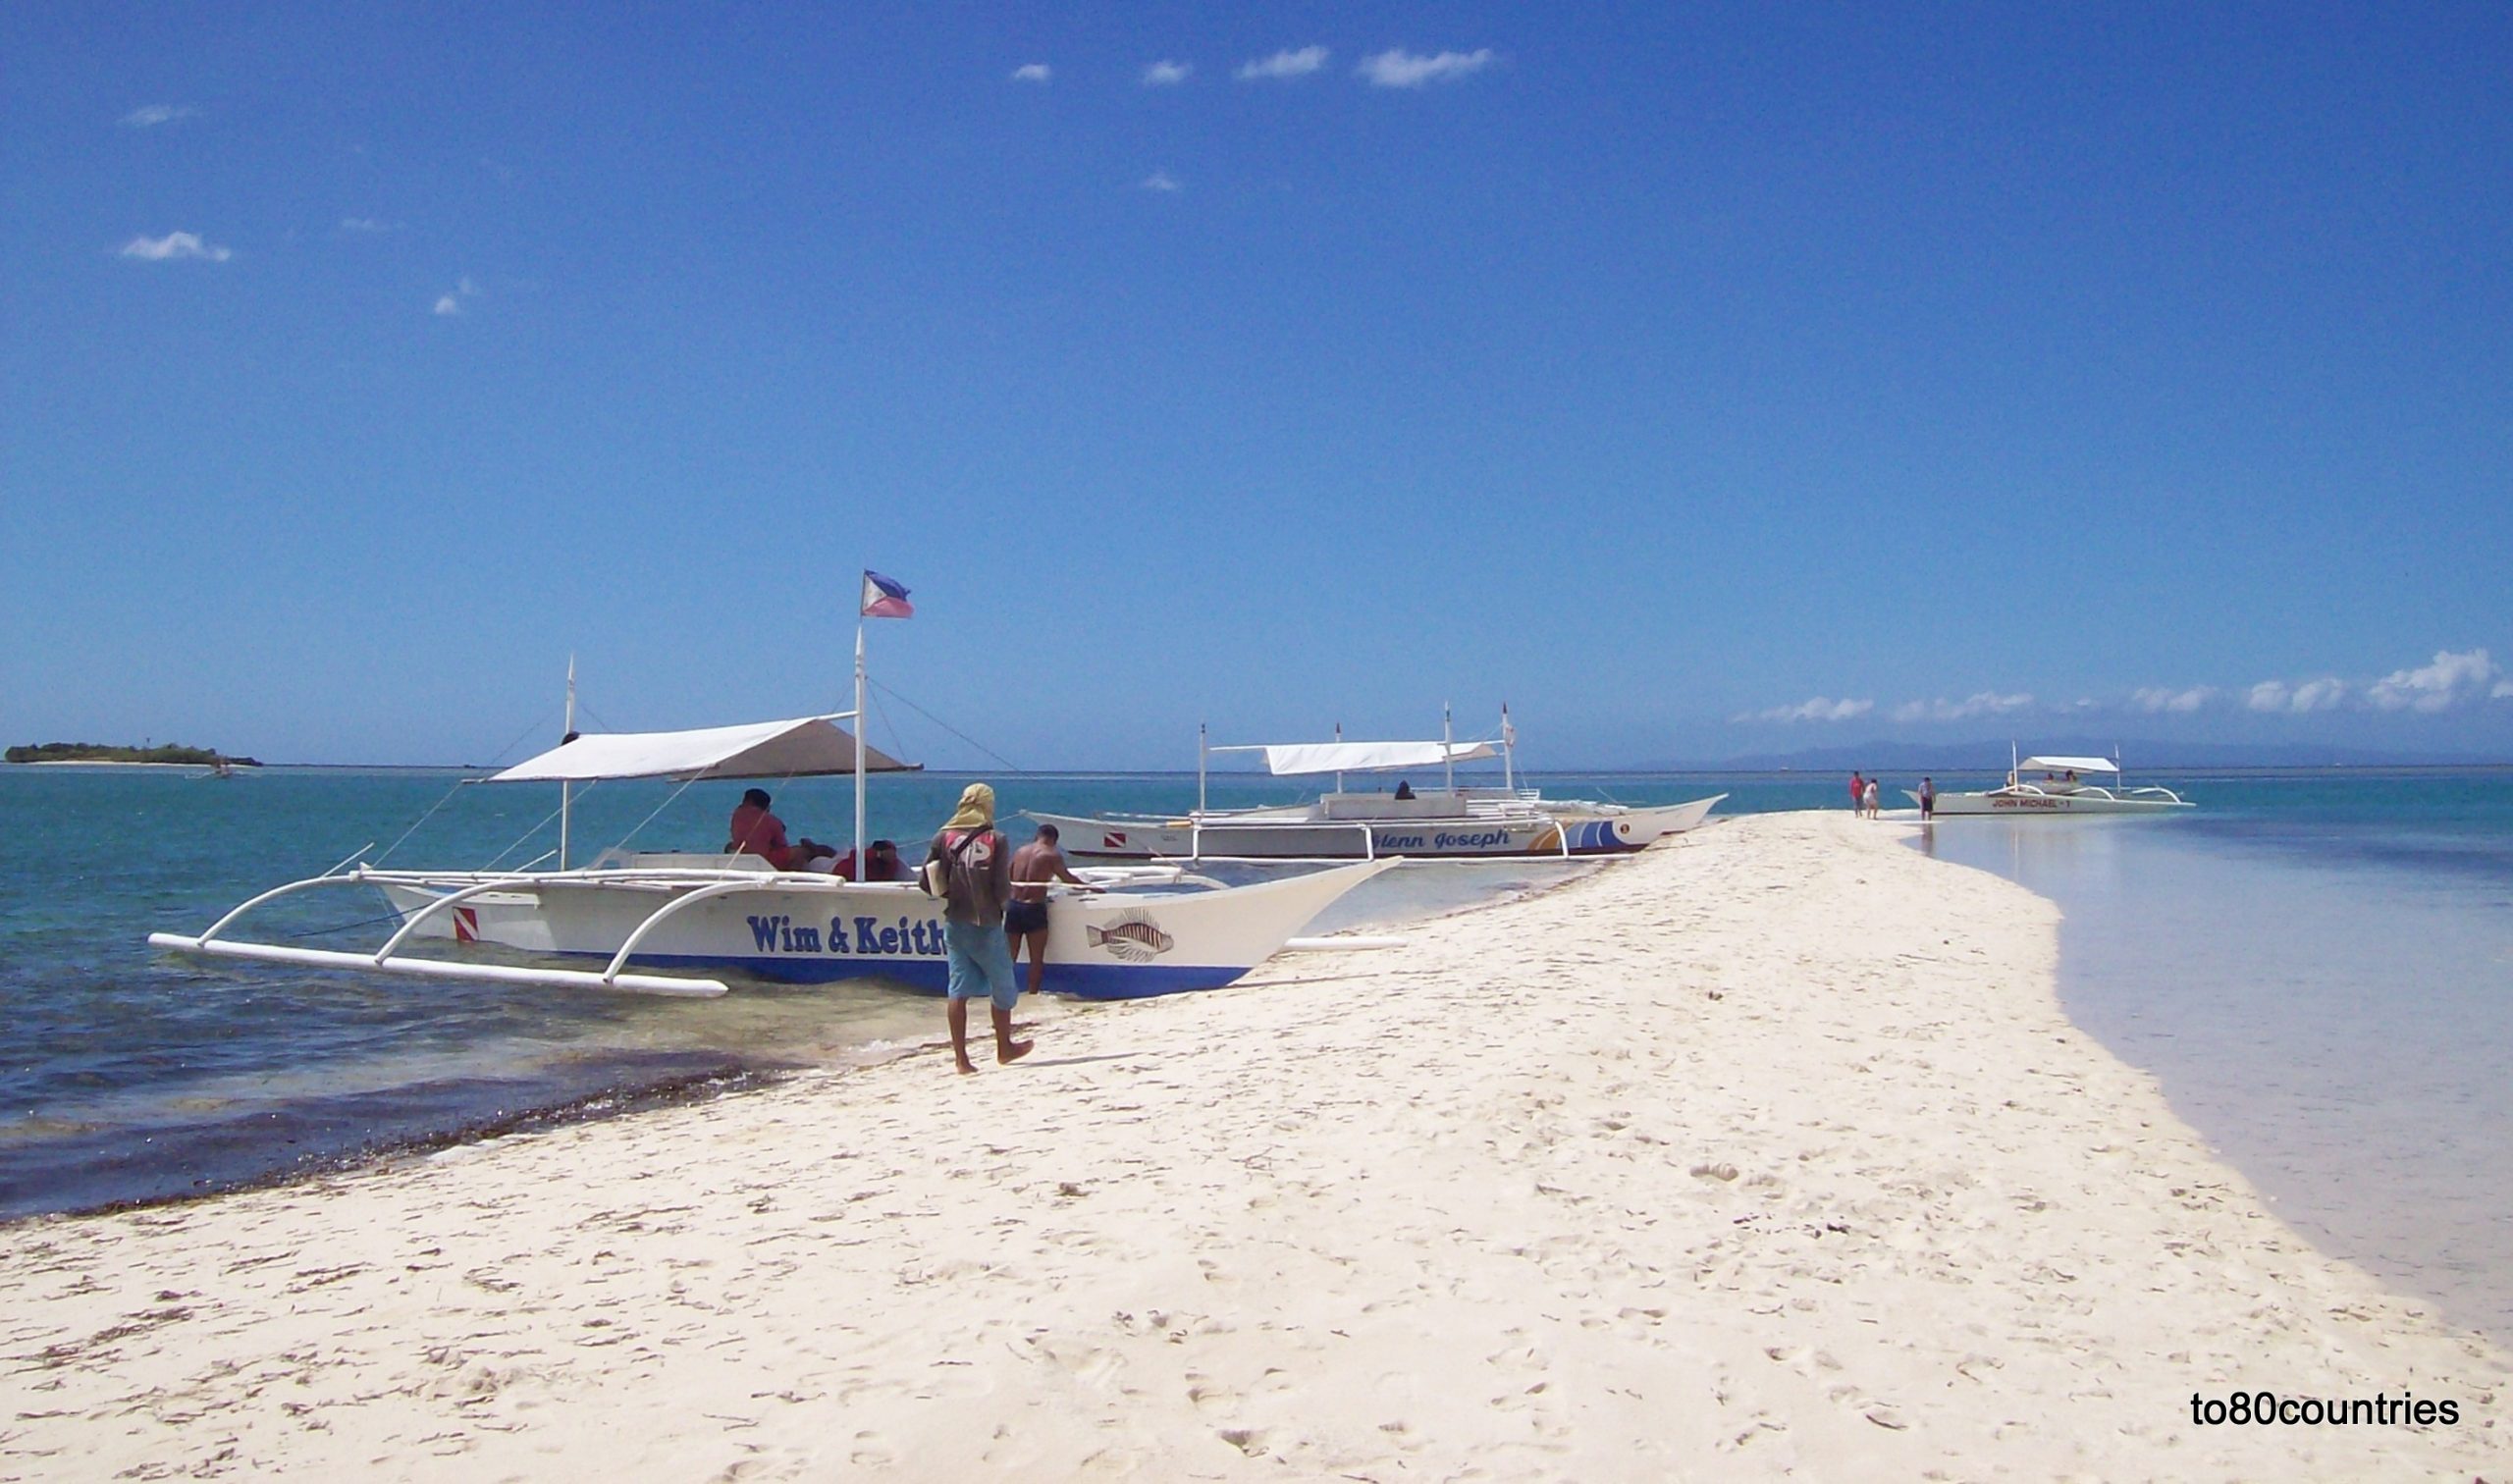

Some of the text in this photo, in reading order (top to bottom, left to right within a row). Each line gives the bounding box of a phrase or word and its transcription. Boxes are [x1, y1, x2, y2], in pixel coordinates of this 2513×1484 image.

[1993, 798, 2017, 808] JOHN
[2019, 798, 2058, 808] MICHAEL
[1434, 828, 1510, 849] Joseph
[746, 915, 948, 955] Wim & Keith
